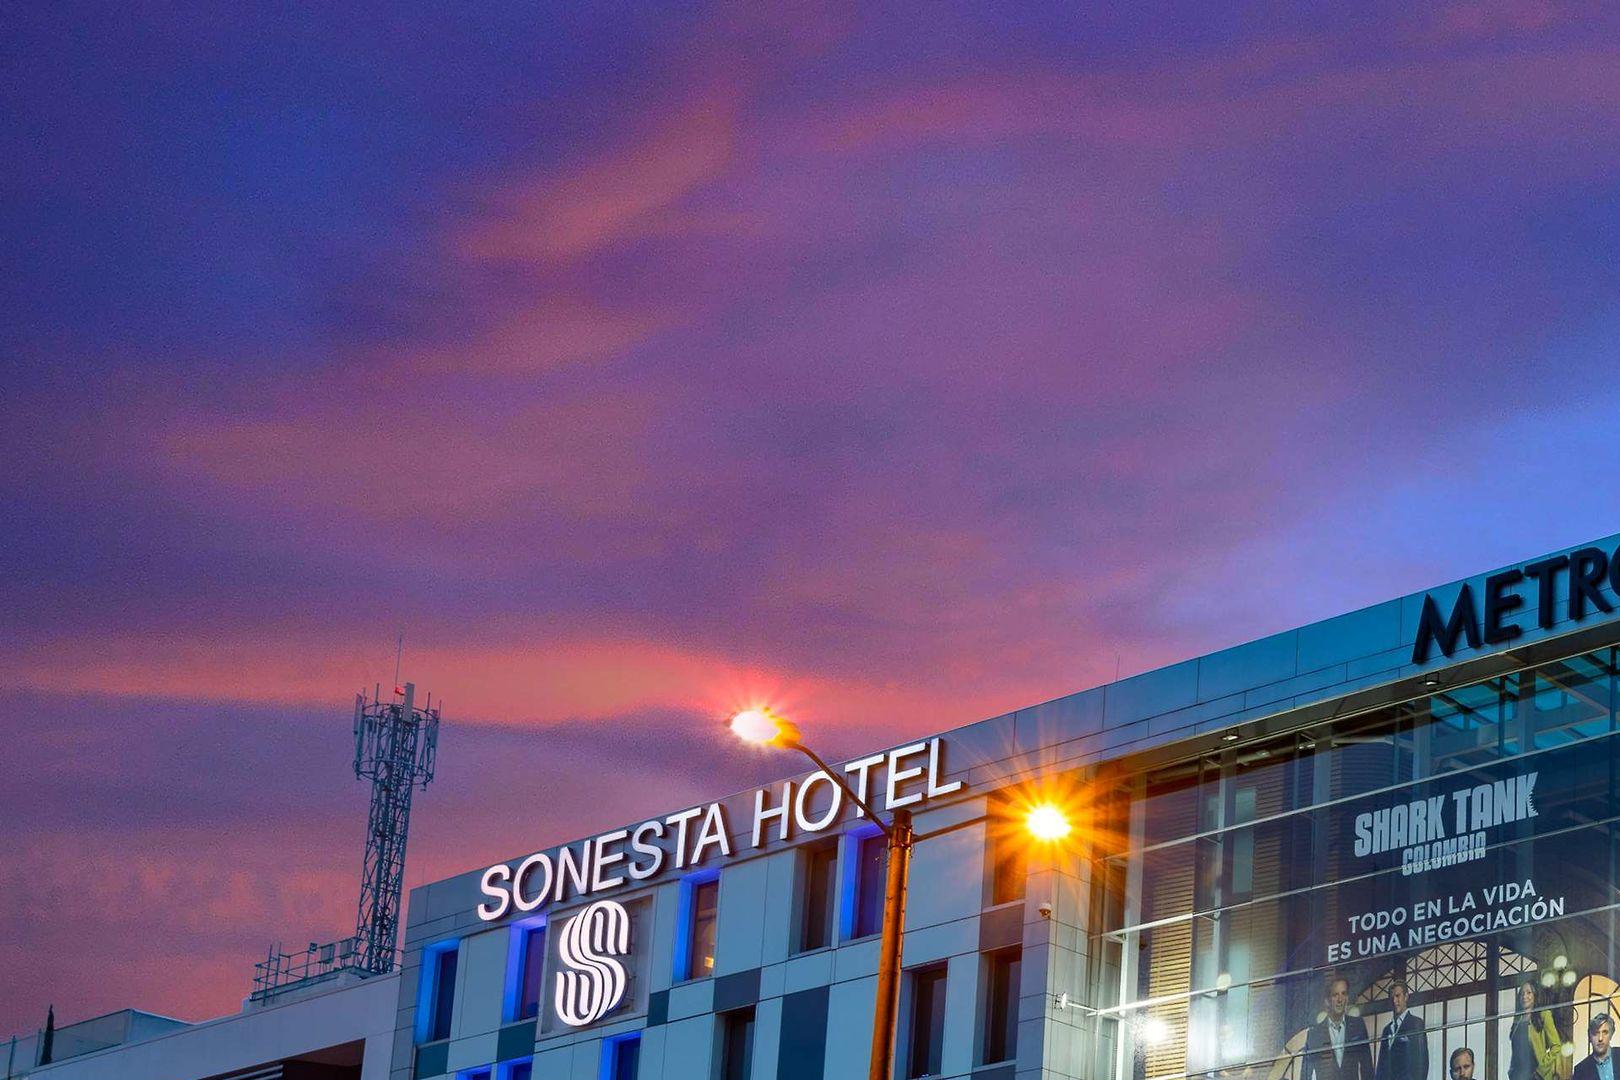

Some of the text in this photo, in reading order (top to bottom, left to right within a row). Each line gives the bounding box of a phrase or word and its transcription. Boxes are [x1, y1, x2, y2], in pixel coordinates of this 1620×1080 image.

[477, 737, 964, 921] SONESTA HOTEL
[1354, 771, 1539, 858] SHARK TANK
[1400, 831, 1487, 876] COLOMBIA
[1327, 896, 1565, 963] ES UNA NEGOCIACIÓN
[1349, 879, 1537, 934] TODO EN LA VIDA
